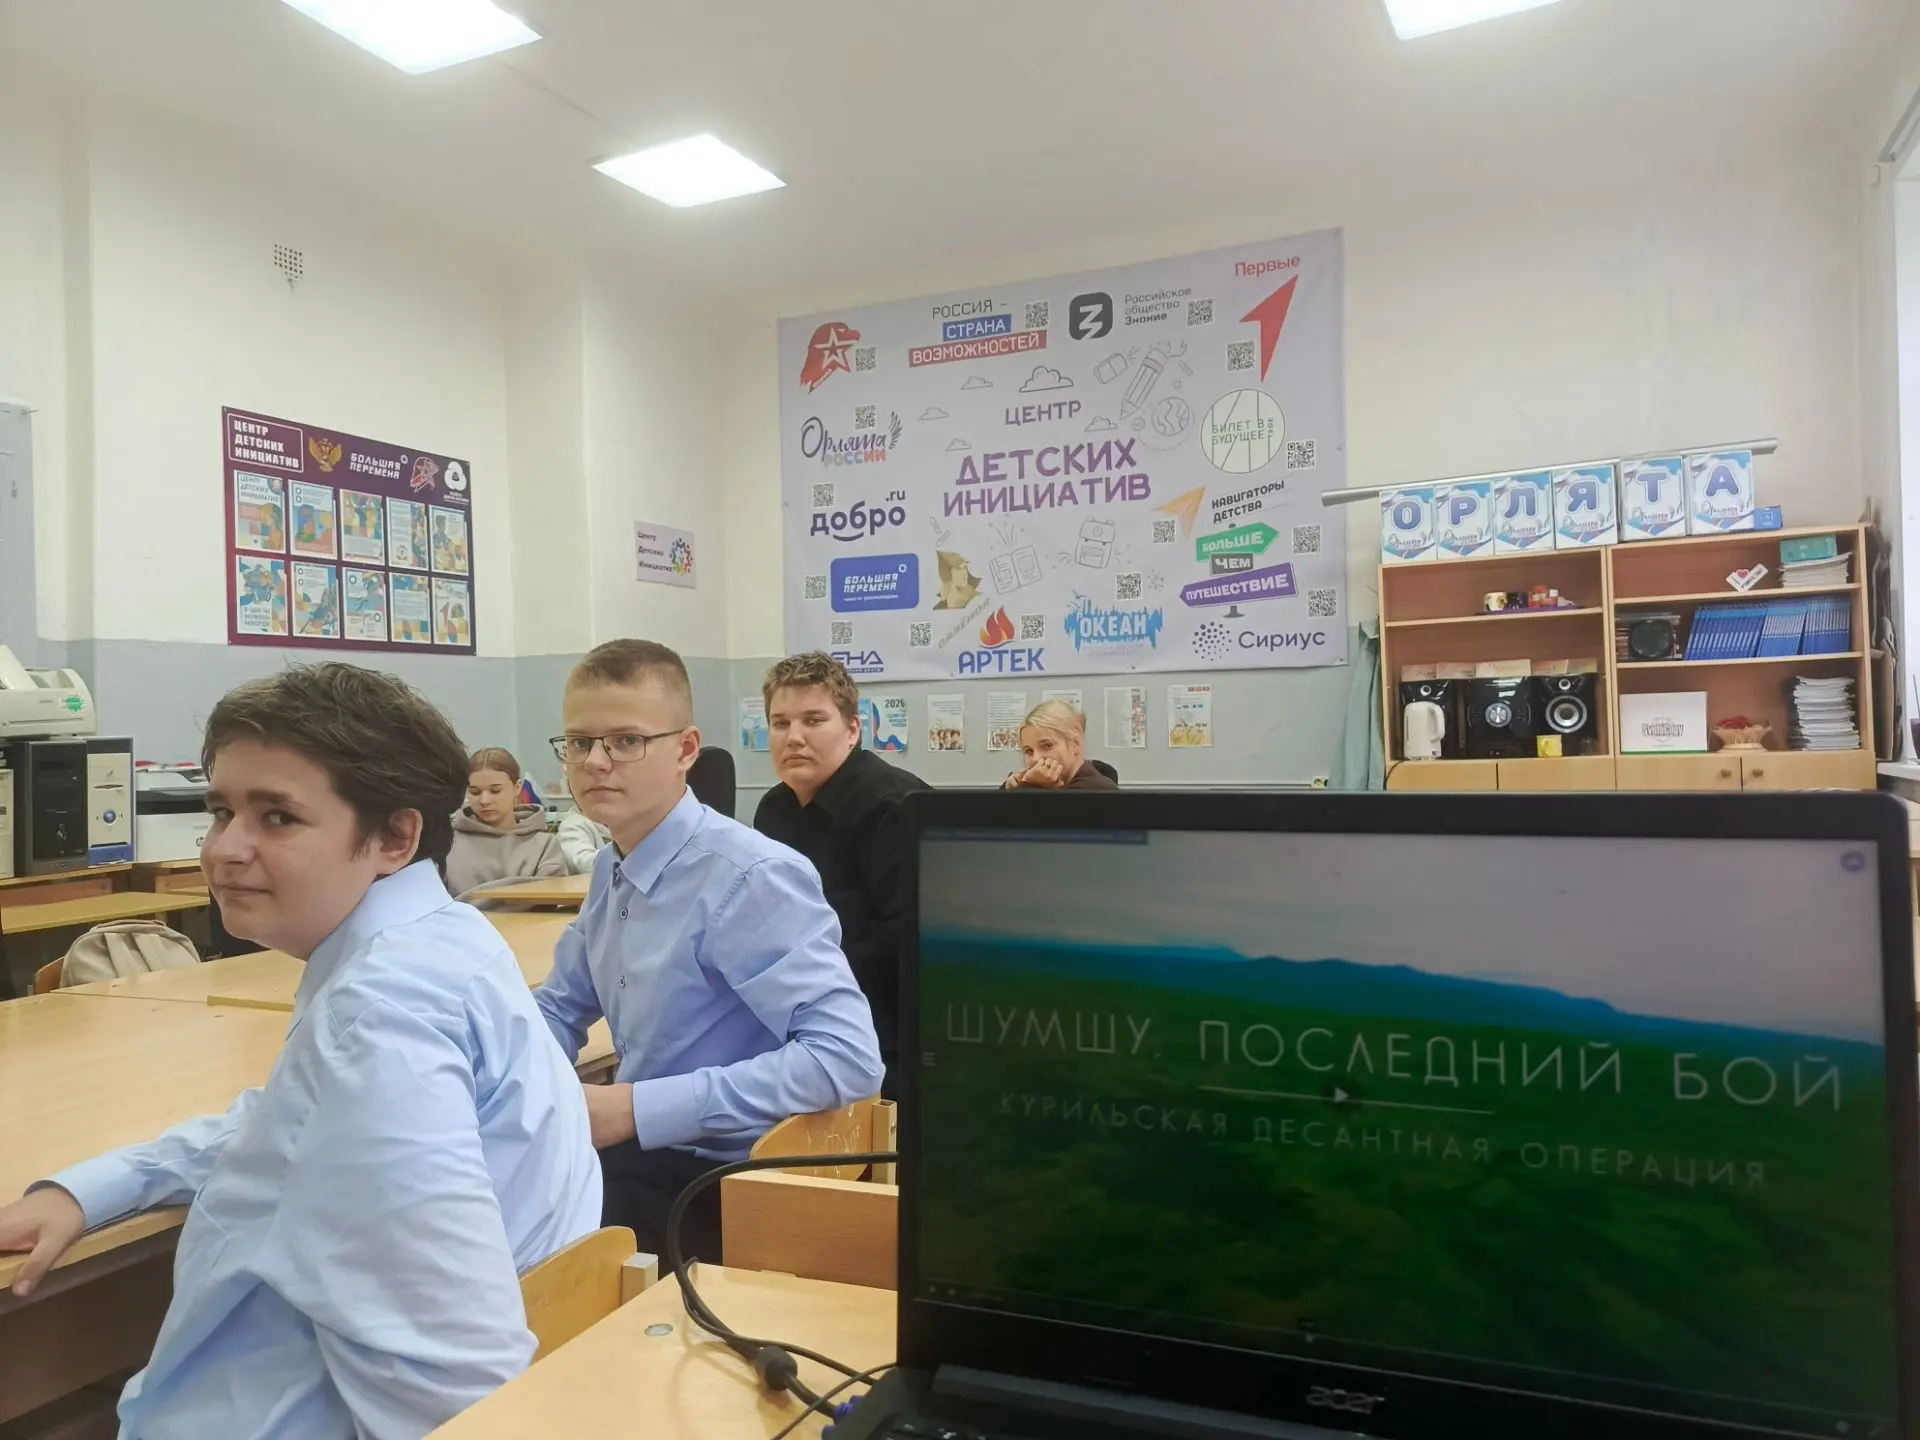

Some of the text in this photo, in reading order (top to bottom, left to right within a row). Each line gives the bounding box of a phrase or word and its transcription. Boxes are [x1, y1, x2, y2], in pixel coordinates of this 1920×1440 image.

[1234, 256, 1300, 278] Первые
[1124, 286, 1192, 305] Российское
[932, 299, 993, 319] РОССИЯ
[1124, 299, 1181, 316] общество
[946, 319, 1006, 339] СТРАНА
[1124, 311, 1168, 326] Знание
[912, 332, 1040, 364] ВОЗМОЖНОСТЕЙ
[1005, 400, 1082, 426] ЦЕНТР
[234, 419, 269, 436] ЦЕНТР
[1212, 420, 1252, 434] БИЛЕТ
[1212, 429, 1265, 445] БУДУЩЕЕ
[234, 433, 284, 453] ДЕТСКИХ
[801, 416, 888, 460] Орлята
[235, 448, 300, 469] ИНИЦИАТИВ
[350, 452, 401, 471] БОЛЬШАЯ
[823, 449, 887, 467] РОССИИ
[956, 437, 1137, 486] ДЕТСКИХ
[349, 463, 400, 480] ПЕРЕМЕНА
[943, 473, 1151, 518] ИНИЦИАТИВ
[1212, 480, 1285, 509] НАВИГАТОРЫ
[810, 500, 906, 537] добро
[1213, 500, 1263, 524] ДЕТСТВА
[1202, 531, 1264, 552] БОЛЬШЕ
[1214, 553, 1252, 570] ЧЕМ
[843, 582, 897, 593] ПЕРЕМЕНА
[844, 573, 898, 585] БОЛЬШАЯ
[1185, 573, 1290, 600] ПУТЕШЕСТВИЕ
[1080, 613, 1147, 638] ОКЕАН
[1238, 630, 1326, 651] Сириус
[958, 648, 1045, 674] АРТЕК
[1199, 1019, 1622, 1095] ПОСЛЕДНИЙ
[1672, 1052, 1841, 1112] БОЙ
[1000, 1091, 1766, 1191] КУРИЛЬСКАЯ ДЕСАНТНАЯ ОПЕРАЦИЯ
